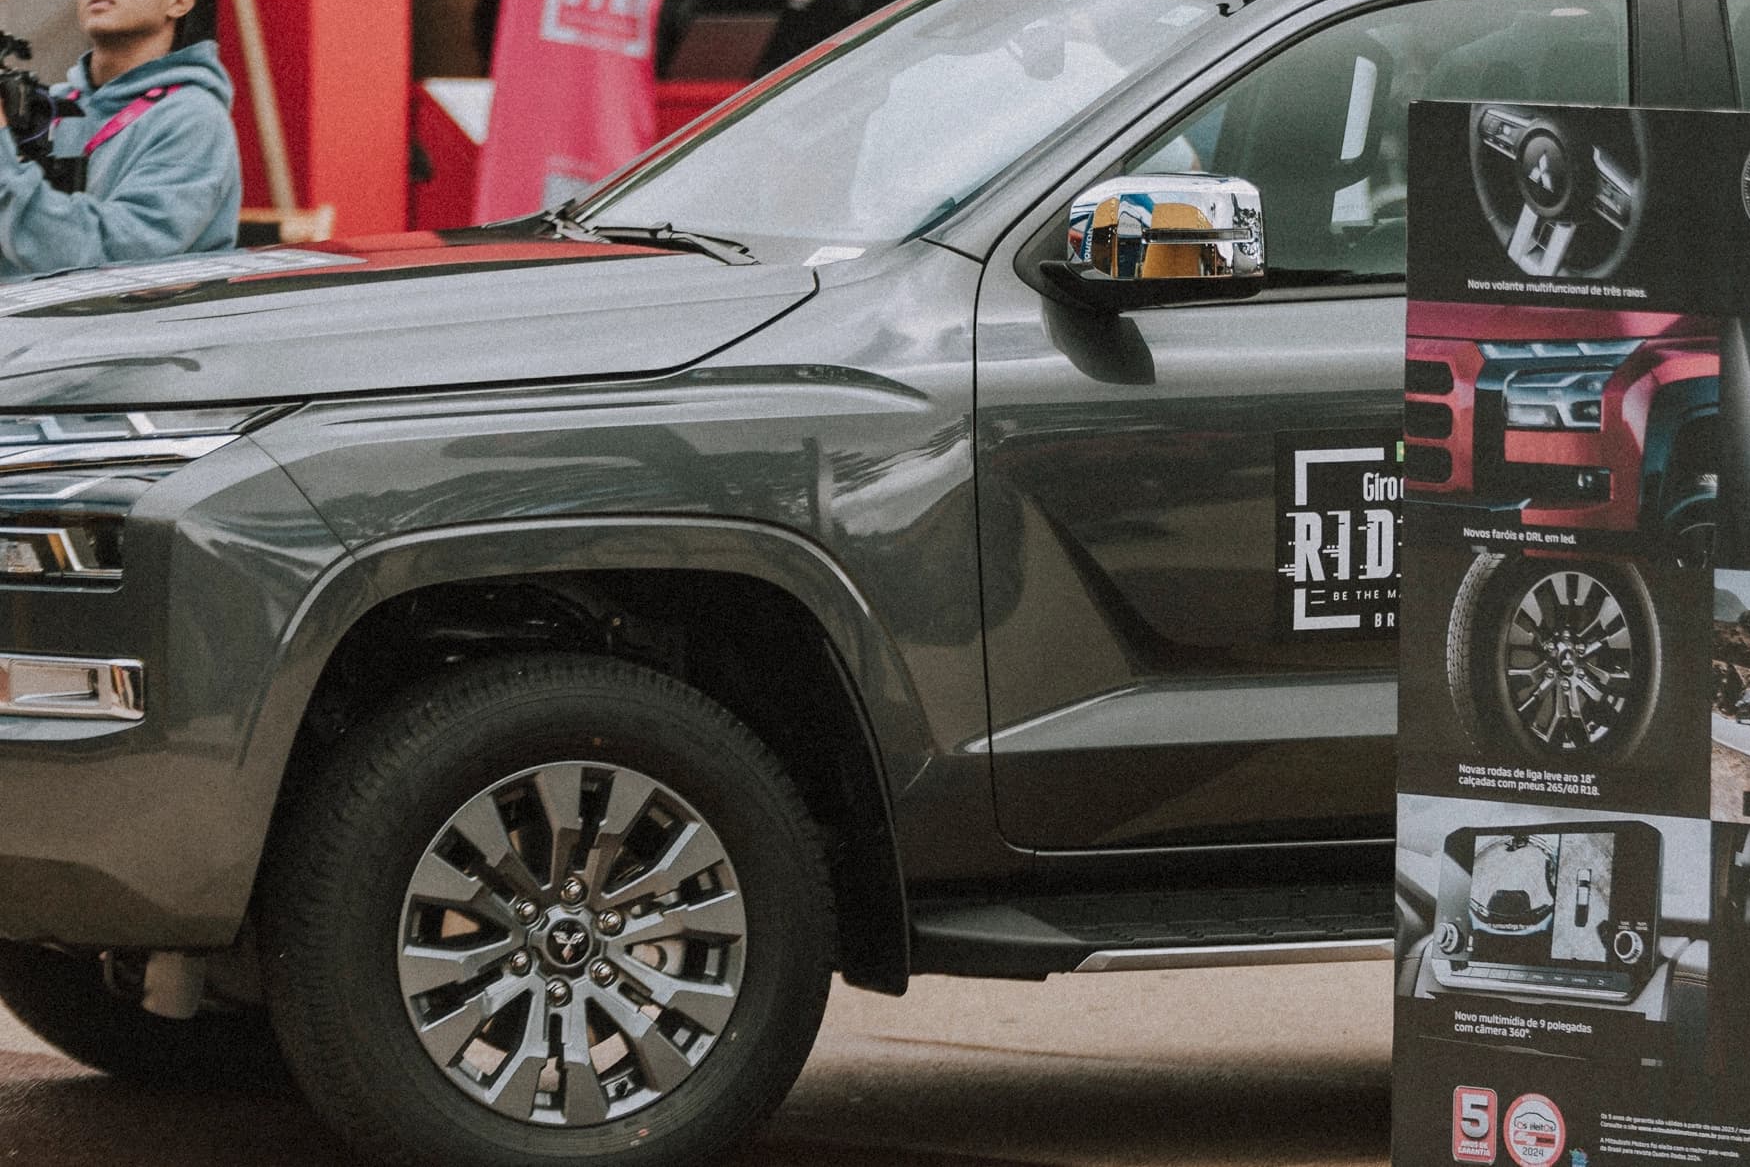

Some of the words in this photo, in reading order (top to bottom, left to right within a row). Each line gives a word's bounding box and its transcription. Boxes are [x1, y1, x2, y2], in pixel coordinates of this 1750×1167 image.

[1467, 280, 1490, 289] Novo
[1492, 281, 1524, 291] volante
[1526, 282, 1589, 294] multifuncional
[1590, 286, 1602, 295] de
[1602, 286, 1622, 296] três
[1362, 471, 1398, 502] Giro
[1278, 508, 1404, 582] RID
[1463, 528, 1491, 538] Novos
[1491, 529, 1517, 540] faróis
[1526, 532, 1544, 542] DRL
[1560, 534, 1577, 544] led.
[1333, 591, 1348, 601] BE
[1356, 589, 1380, 600] THE
[1458, 764, 1486, 775] Novas
[1487, 767, 1512, 777] rodas
[1513, 769, 1525, 778] de
[1526, 769, 1542, 780] liga
[1543, 771, 1561, 781] leve
[1563, 774, 1578, 782] aro
[1458, 777, 1496, 787] calçadas
[1497, 780, 1516, 788] com
[1518, 782, 1545, 791] pneus
[1546, 782, 1579, 794] 265/60
[1580, 785, 1600, 795] R18.
[1454, 1011, 1477, 1022] Novo
[1478, 1015, 1526, 1026] multimídia
[1526, 1018, 1538, 1028] de
[1539, 1019, 1546, 1028] 9
[1547, 1021, 1592, 1033] polegadas
[1454, 1024, 1474, 1032] com
[1474, 1025, 1507, 1036] câmera
[1460, 1093, 1489, 1138] 5
[1522, 1146, 1544, 1157] 2024
